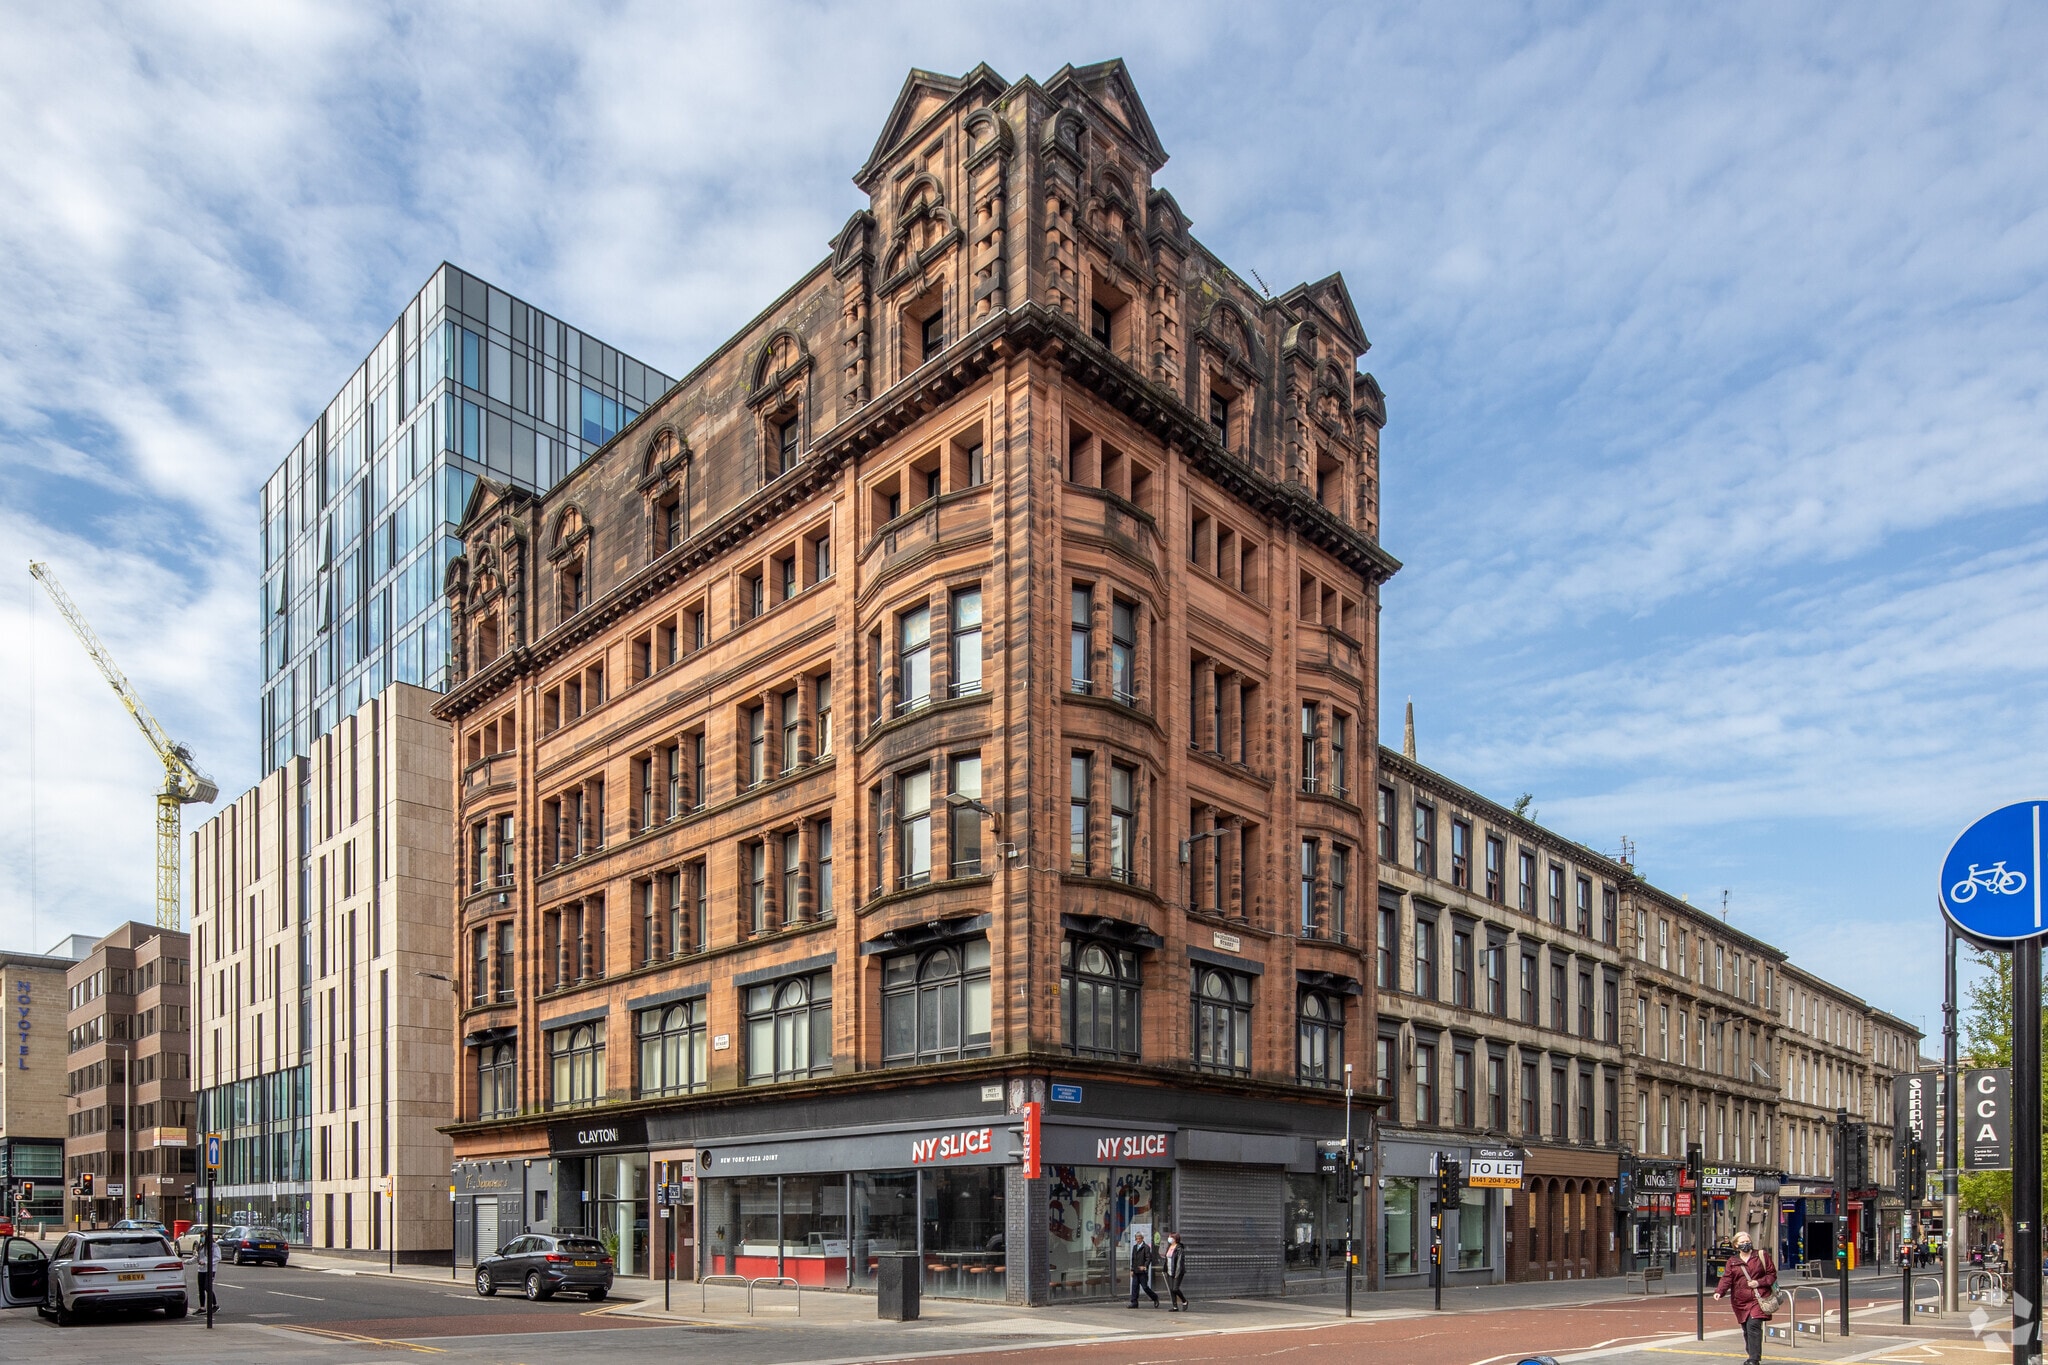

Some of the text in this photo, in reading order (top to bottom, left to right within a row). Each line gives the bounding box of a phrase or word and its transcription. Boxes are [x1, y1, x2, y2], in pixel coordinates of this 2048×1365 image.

[17, 980, 31, 1070] NOVOTEL
[1976, 1075, 1998, 1142] CCA
[578, 1128, 616, 1144] CLAYTON
[912, 1127, 992, 1163] NY SLICE
[1097, 1134, 1167, 1162] NY SLICE
[1480, 1149, 1497, 1157] Glen
[1503, 1149, 1514, 1157] Co
[1471, 1162, 1491, 1174] TO
[1496, 1163, 1522, 1175] LET
[1703, 1167, 1730, 1175] CDLH
[1644, 1174, 1666, 1187] KINGS
